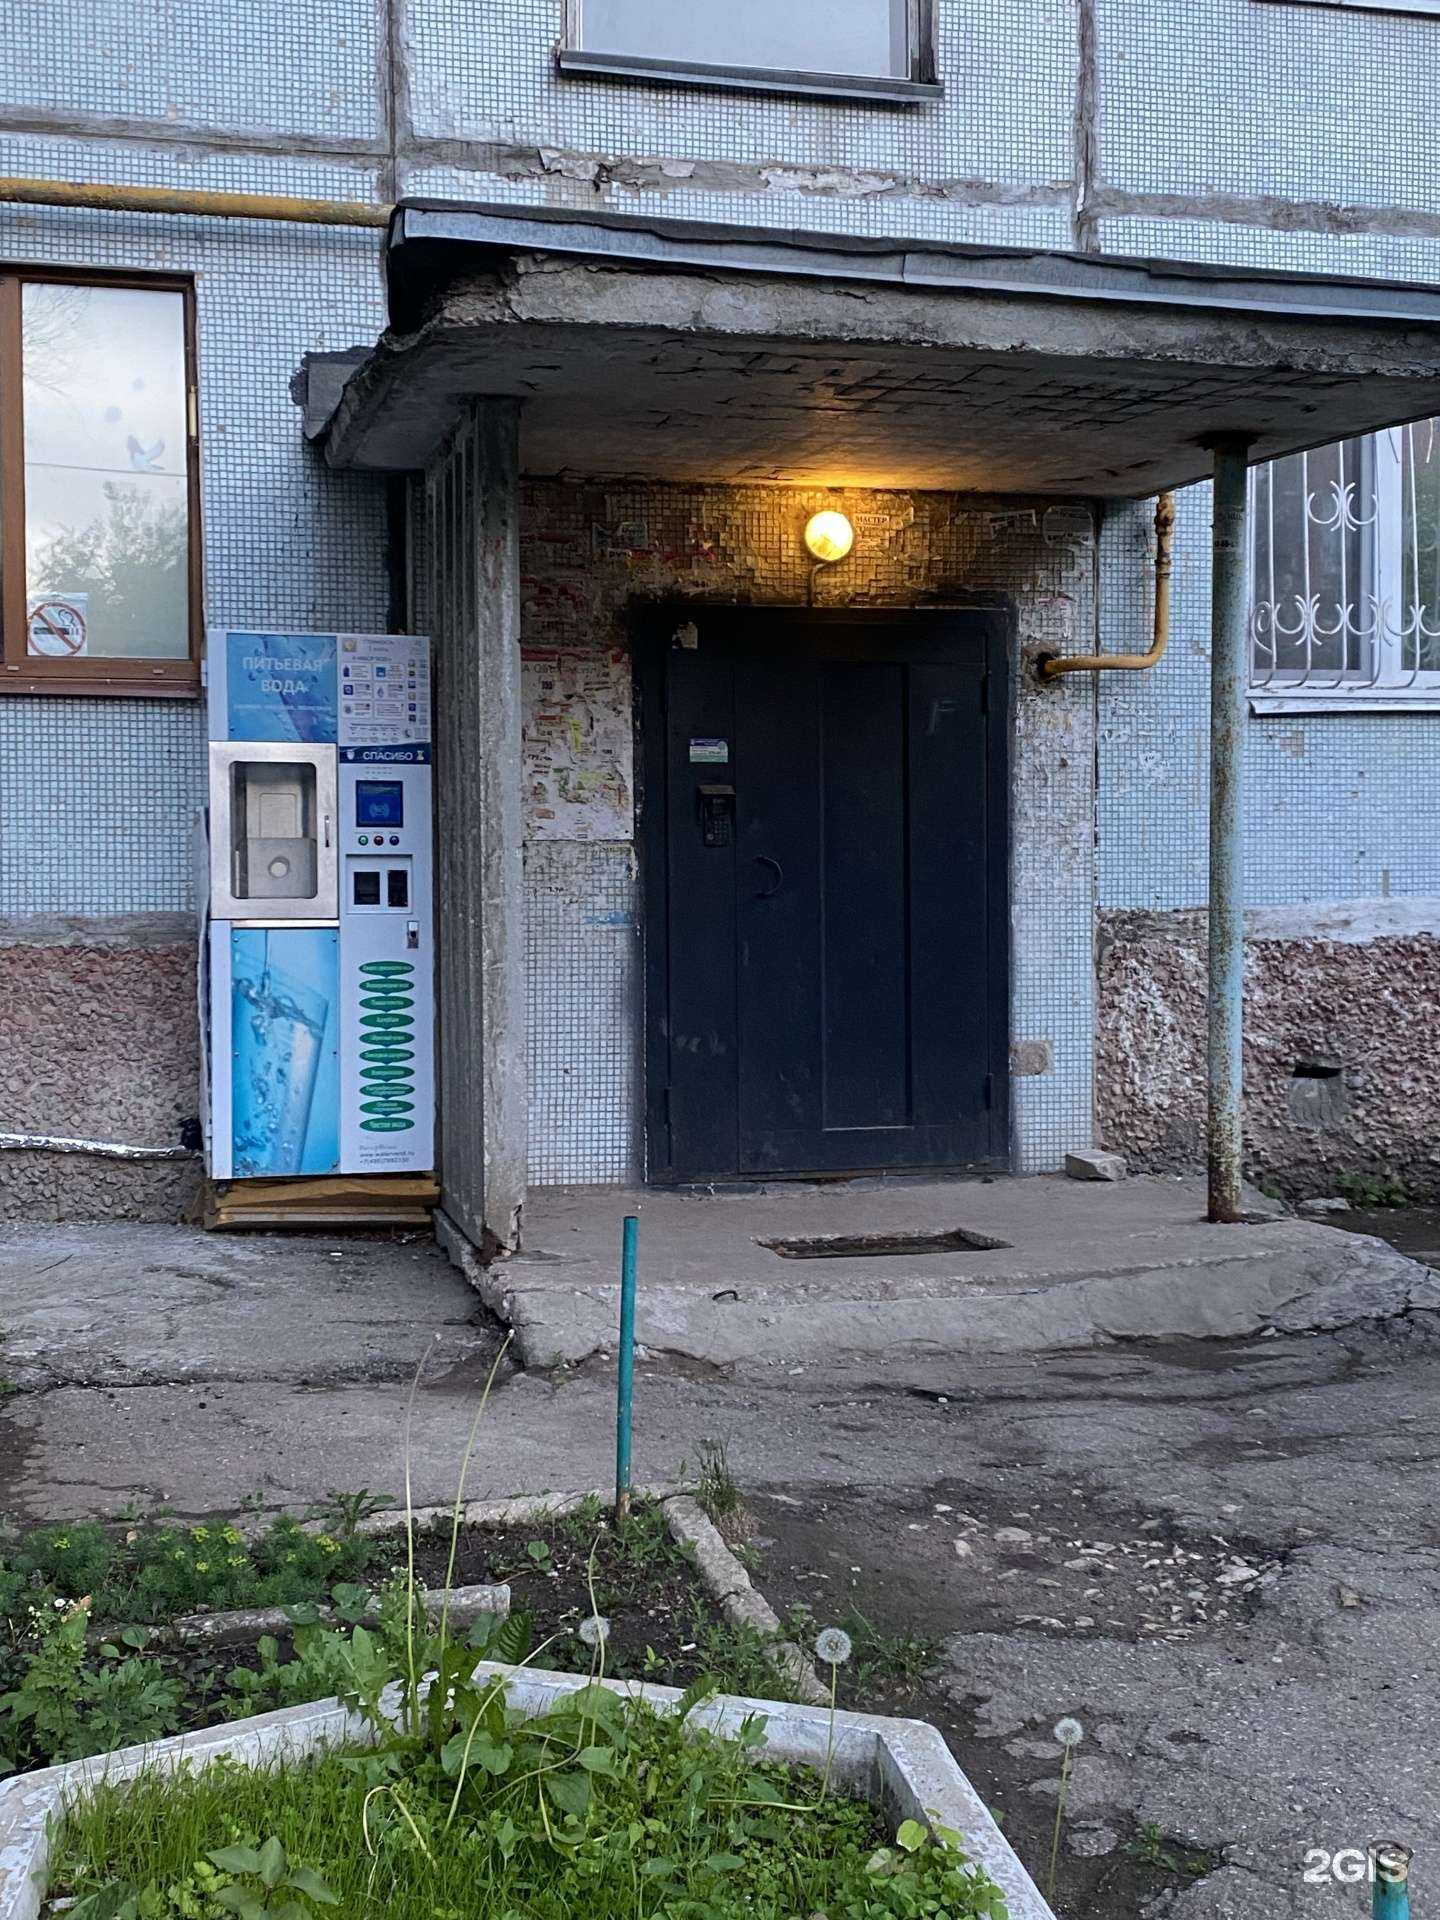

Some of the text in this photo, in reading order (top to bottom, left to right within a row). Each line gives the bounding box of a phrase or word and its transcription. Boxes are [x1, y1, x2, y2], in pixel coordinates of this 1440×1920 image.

[242, 656, 323, 672] ПИТЬЕВАЯ
[261, 679, 307, 696] ВОДА
[362, 751, 413, 761] СПАСИБО
